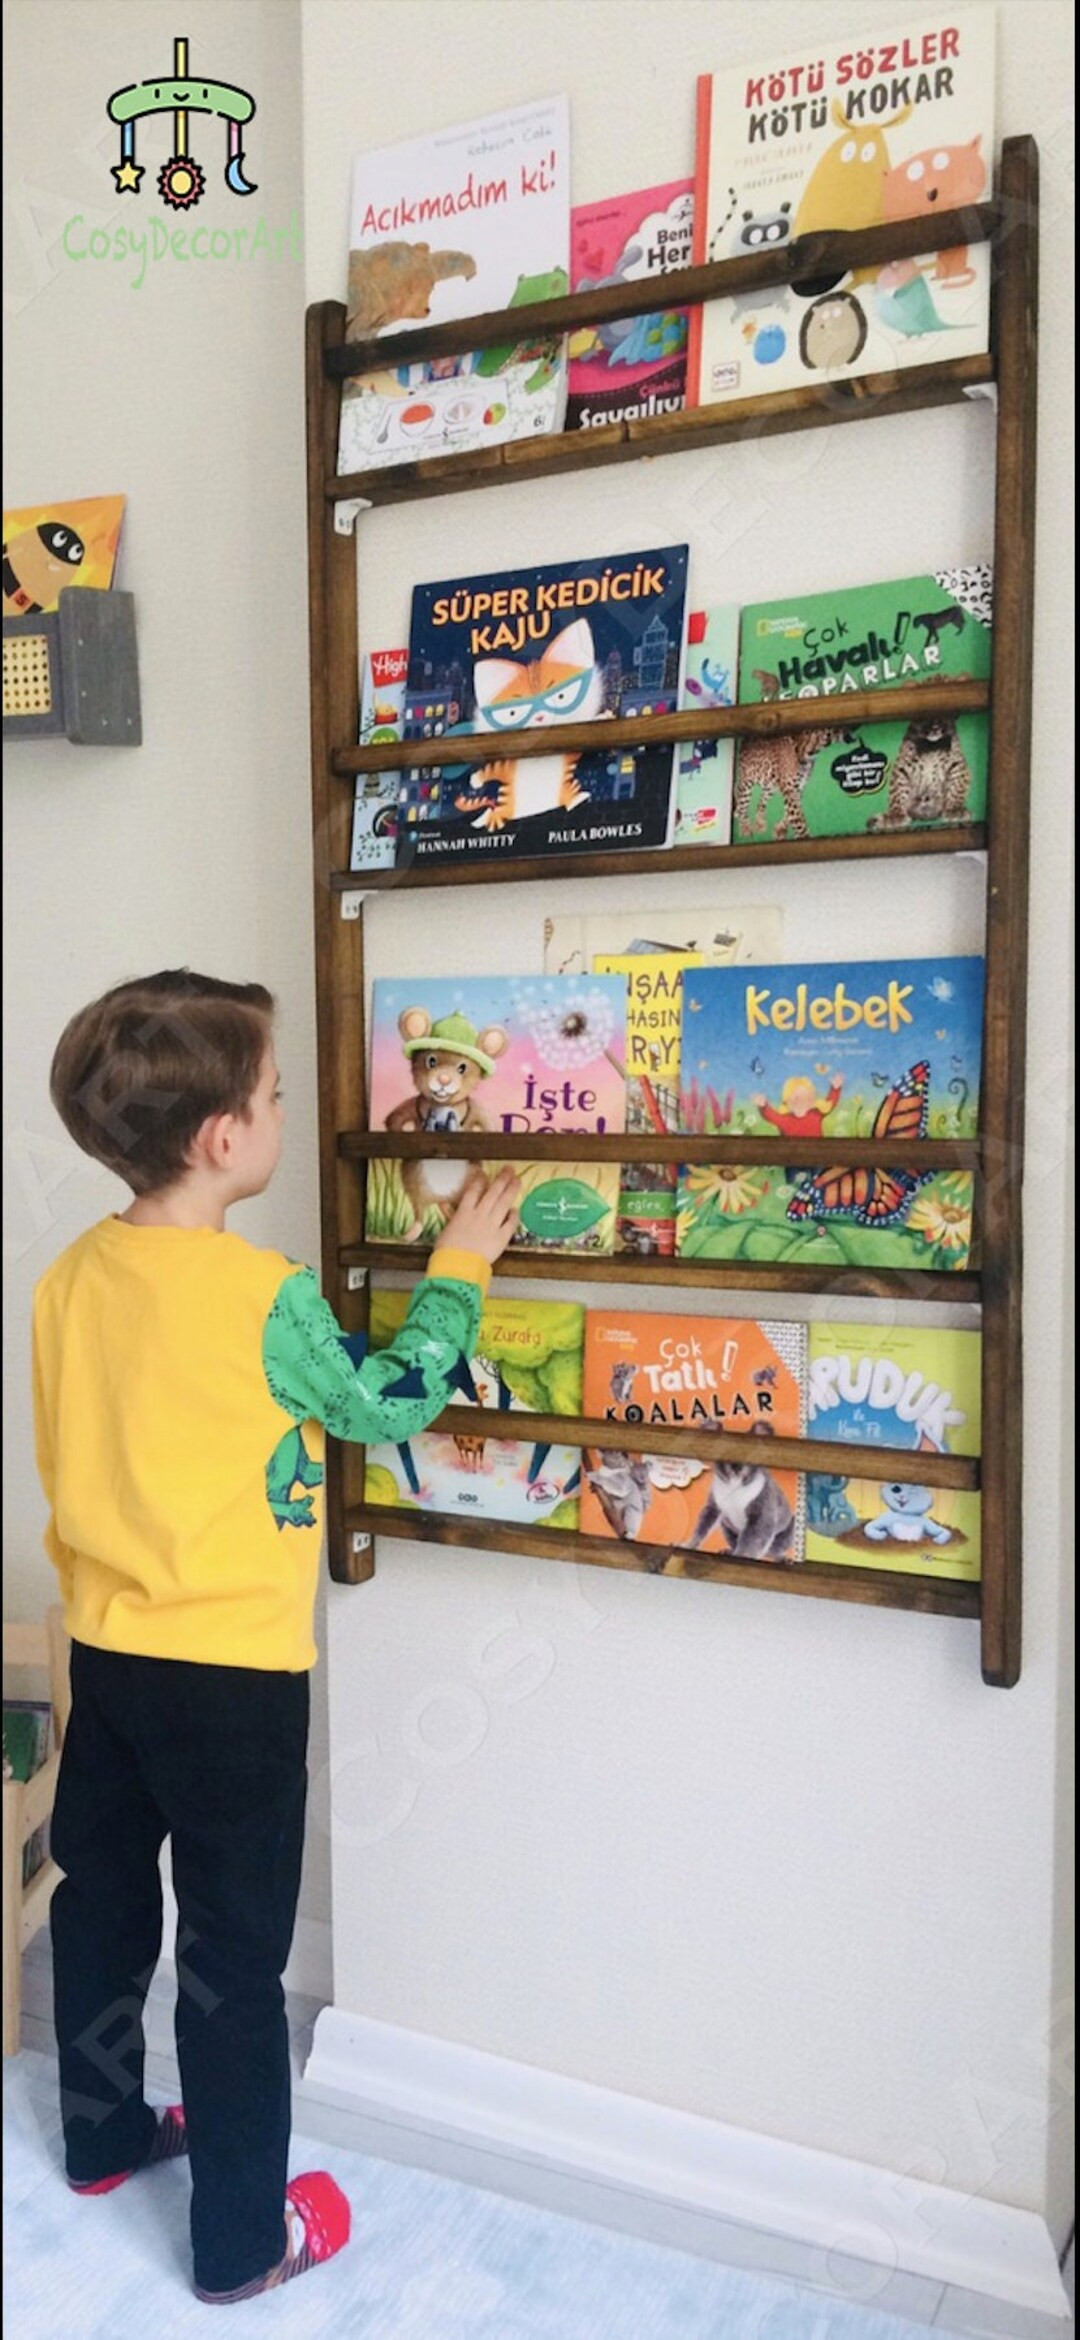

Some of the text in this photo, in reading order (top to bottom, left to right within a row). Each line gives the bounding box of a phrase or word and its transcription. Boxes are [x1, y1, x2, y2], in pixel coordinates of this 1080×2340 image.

[746, 27, 960, 108] KÖTÜ SÖZLER
[748, 67, 954, 143] KÖTÜ KOKAR
[361, 151, 557, 236] Acıkmadım ki!
[656, 223, 693, 245] Beni
[647, 245, 691, 268] Her
[431, 564, 665, 627] SÜPER KEDİCİK
[471, 611, 551, 654] KAJU
[803, 617, 849, 657] Çok
[416, 822, 643, 854] HANNAH WHITTY PAULA BOWLES
[745, 981, 915, 1035] Kelebek
[524, 1074, 597, 1121] İşte
[660, 1336, 702, 1368] Çok
[605, 1391, 774, 1422] KOALALAR
